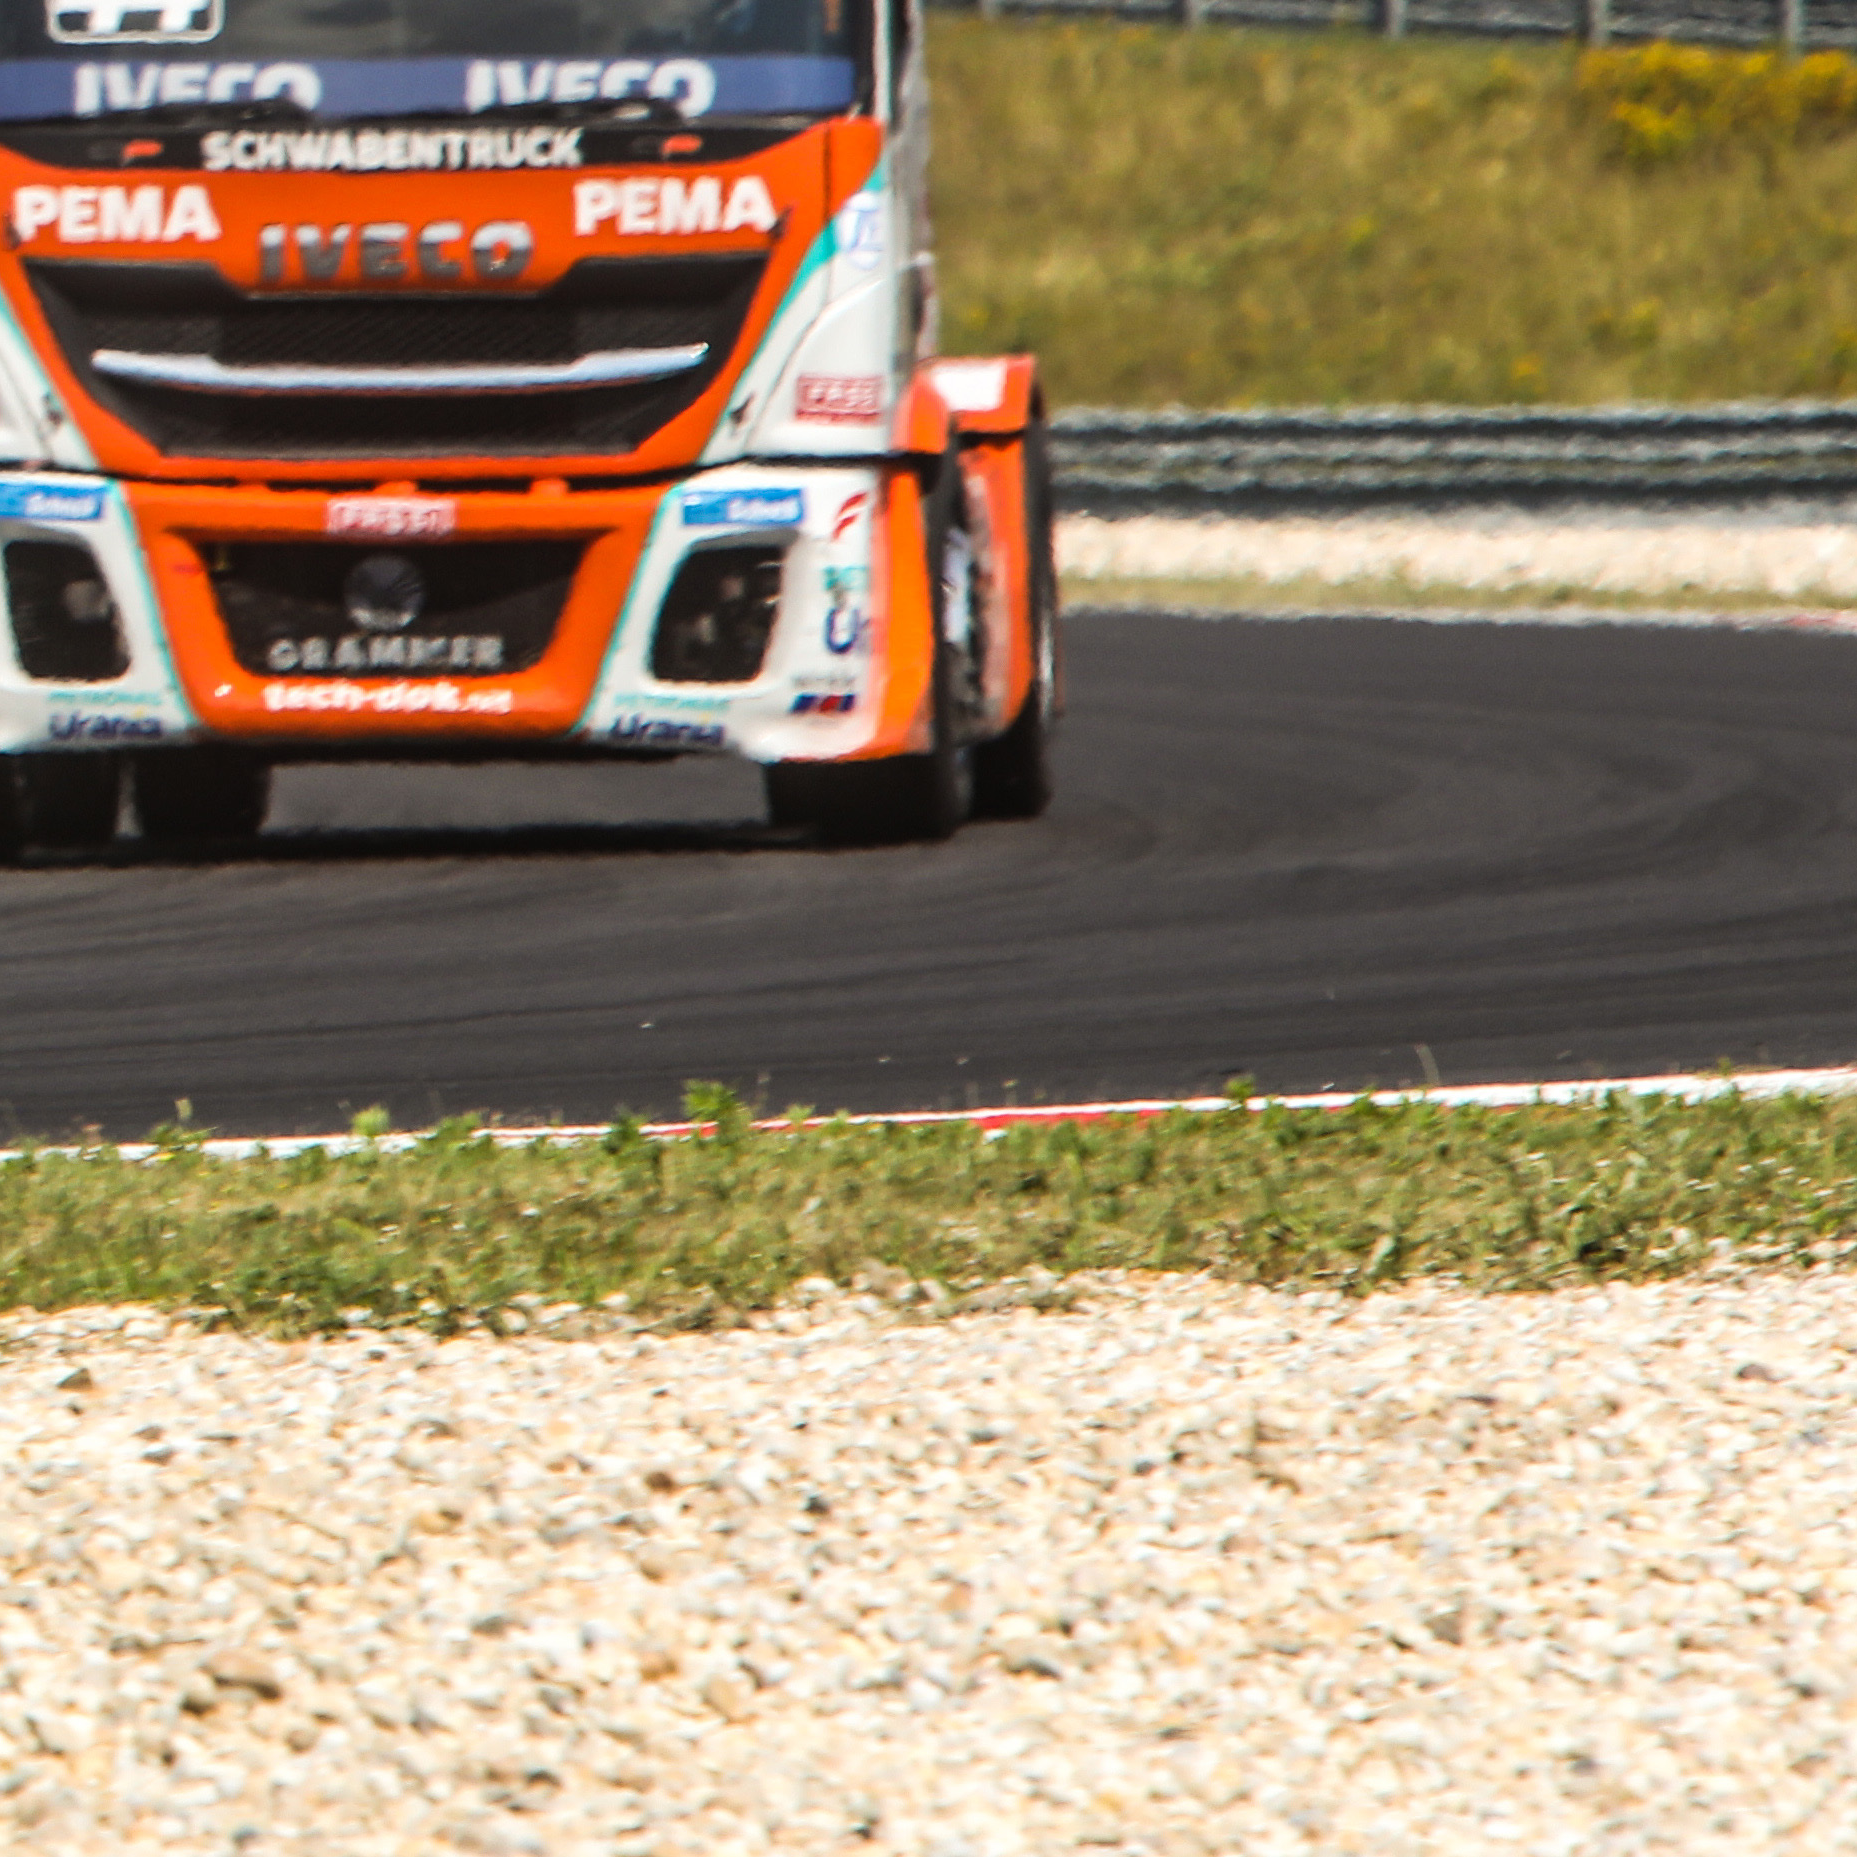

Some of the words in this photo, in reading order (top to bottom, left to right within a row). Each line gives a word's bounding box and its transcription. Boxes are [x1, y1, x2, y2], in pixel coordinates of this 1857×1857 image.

[201, 129, 584, 170] SCHWABENTRUCK
[13, 186, 221, 242] PEMA
[573, 176, 777, 236] PEMA
[259, 222, 534, 282] IVECO
